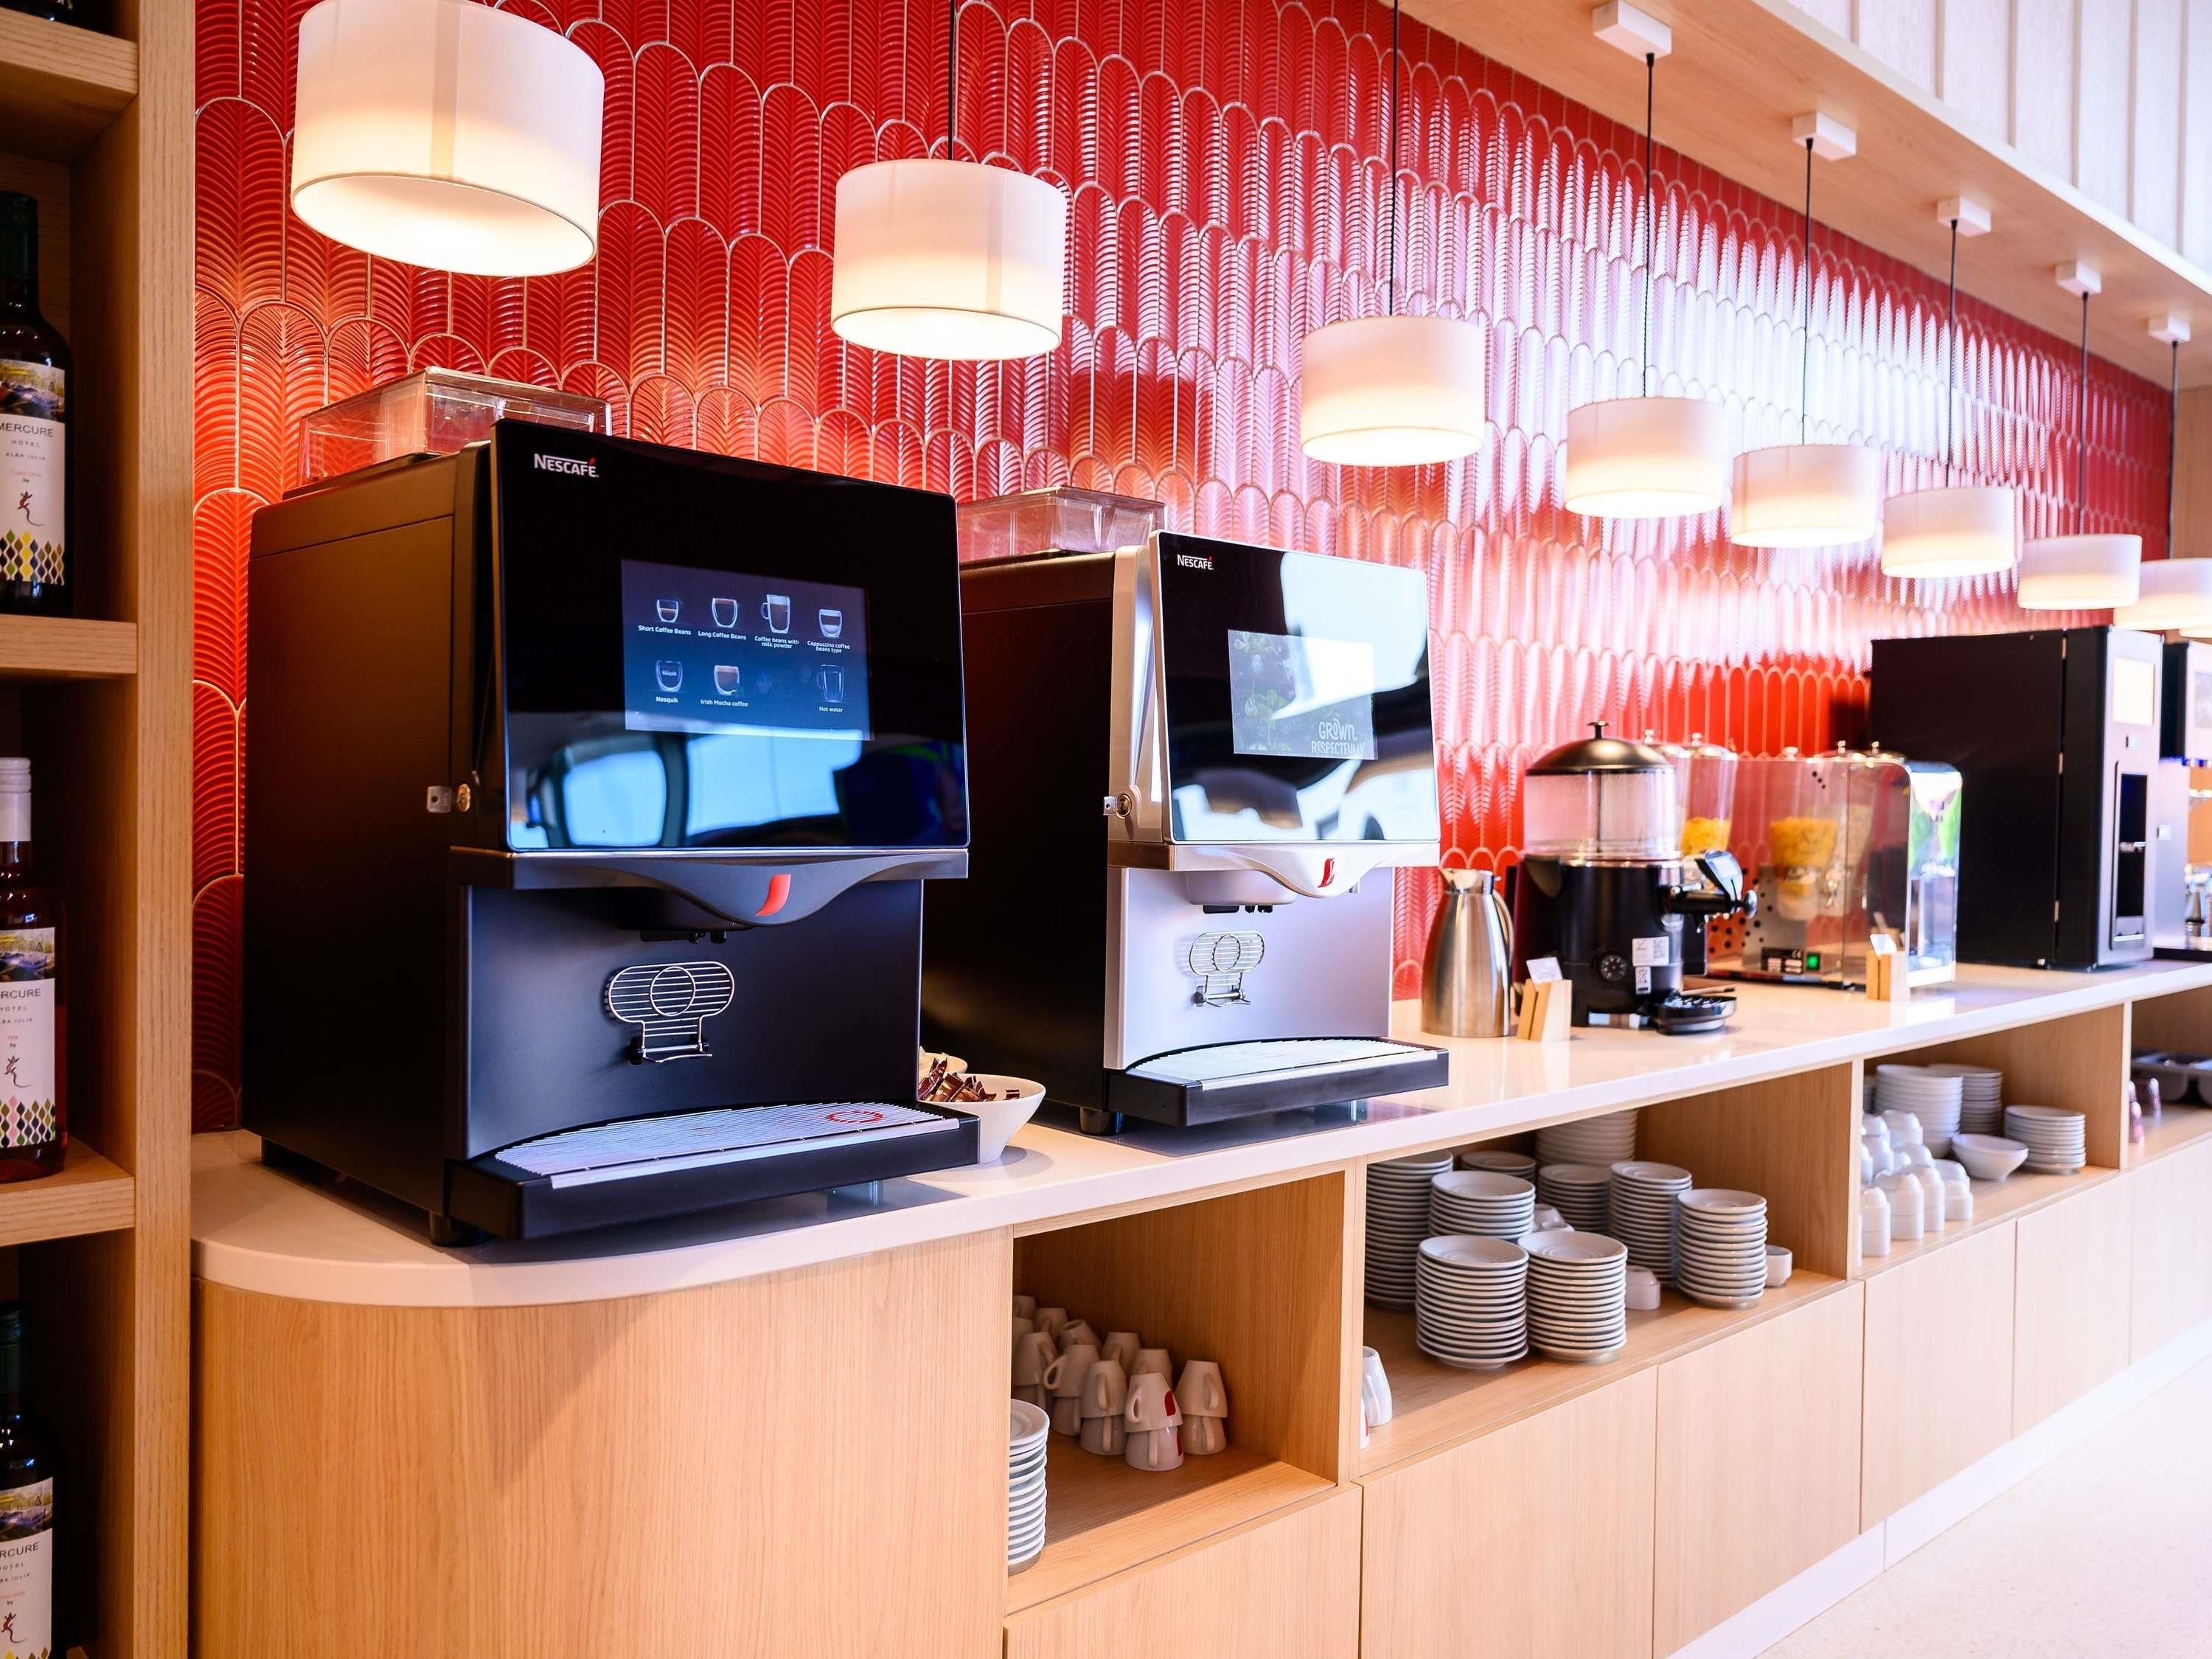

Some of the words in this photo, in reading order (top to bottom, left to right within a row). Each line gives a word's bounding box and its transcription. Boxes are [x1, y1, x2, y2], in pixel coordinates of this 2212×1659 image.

[12, 440, 41, 448] HOTEL
[698, 630, 712, 639] Long
[807, 640, 835, 648] Cappuccino
[0, 989, 41, 999] RCURE
[0, 1541, 40, 1558] RCURE
[0, 1562, 24, 1571] OTEL
